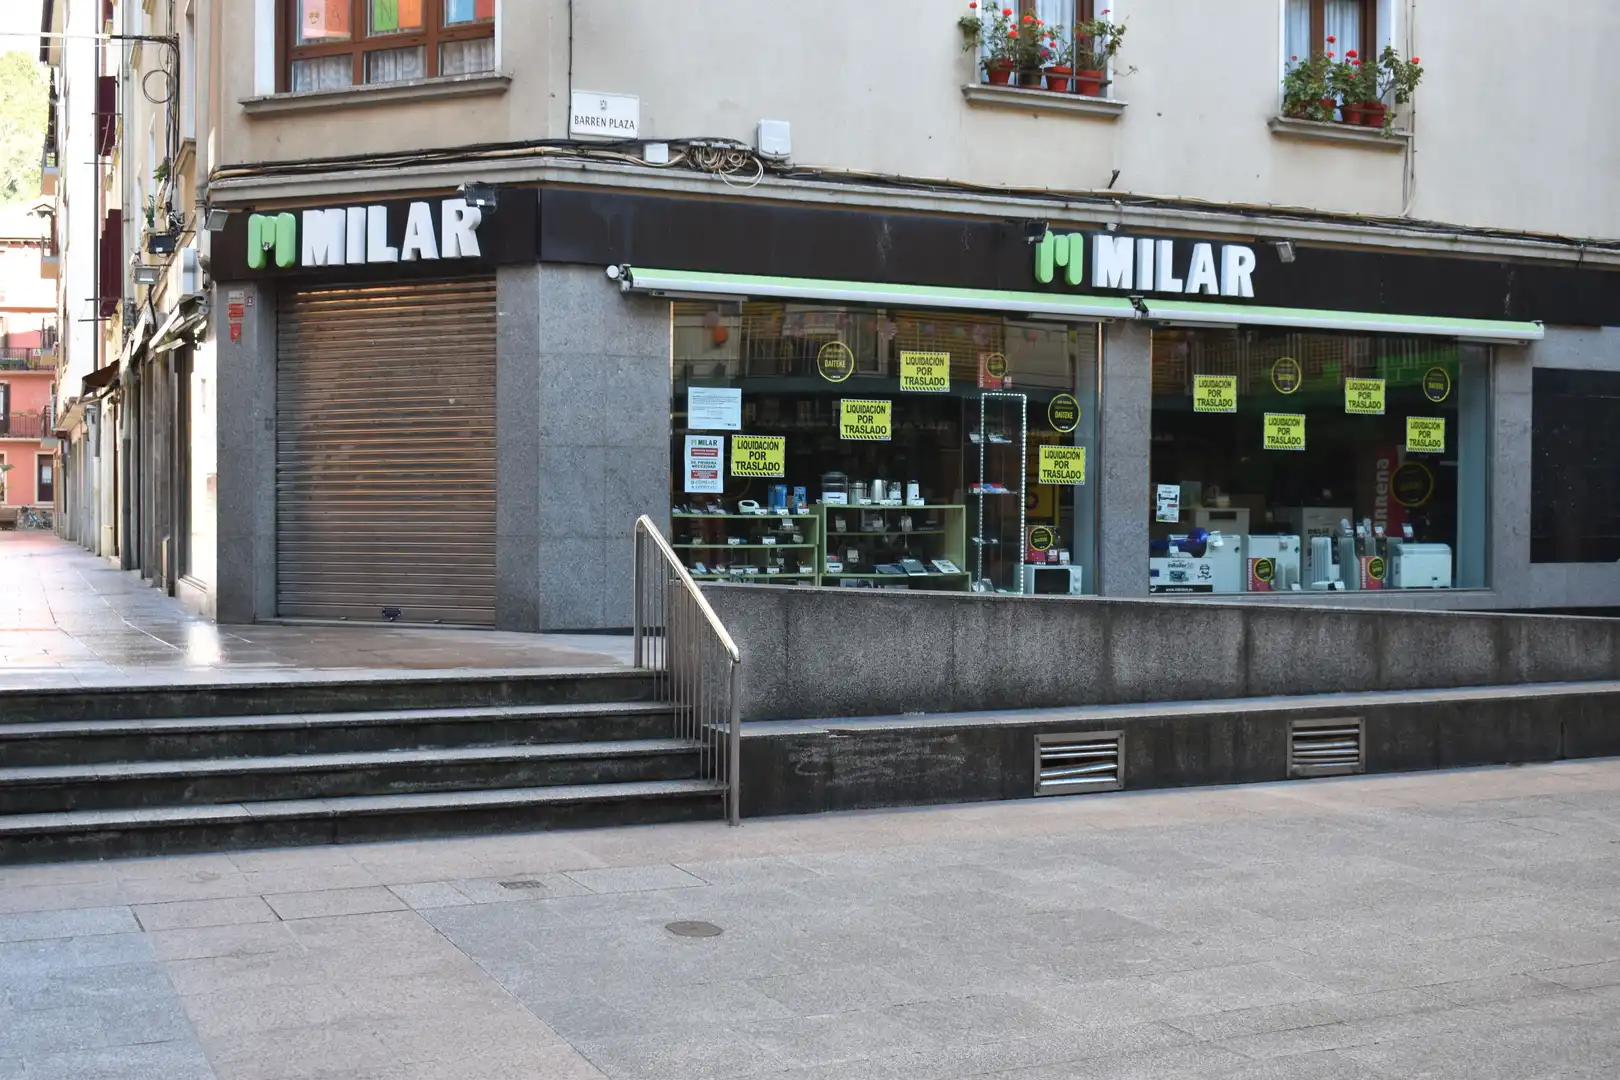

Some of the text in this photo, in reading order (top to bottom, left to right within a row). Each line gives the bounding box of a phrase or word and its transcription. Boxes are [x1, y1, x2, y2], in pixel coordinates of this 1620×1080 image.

[574, 115, 635, 130] BARREN PLAZA
[301, 198, 482, 267] MILAR
[1092, 233, 1256, 298] MILAR
[916, 367, 933, 376] POR
[904, 376, 946, 386] TRASLADO
[1207, 389, 1222, 398] POR
[1357, 391, 1372, 400] POR
[1197, 398, 1233, 407] TRASLADO
[1348, 400, 1382, 409] TRASLADO
[857, 415, 874, 424] POR
[844, 424, 887, 435] TRASLADO
[1277, 427, 1291, 435] POR
[1418, 430, 1431, 438] POR
[1267, 435, 1302, 445] TRASLADO
[1409, 438, 1441, 448] TRASLADO
[737, 440, 779, 450] LIQUIDACIÓN
[749, 451, 766, 460] POR
[736, 461, 780, 472] TRASLADO
[1054, 460, 1070, 469] POR
[1042, 470, 1081, 479] TRASLADO
